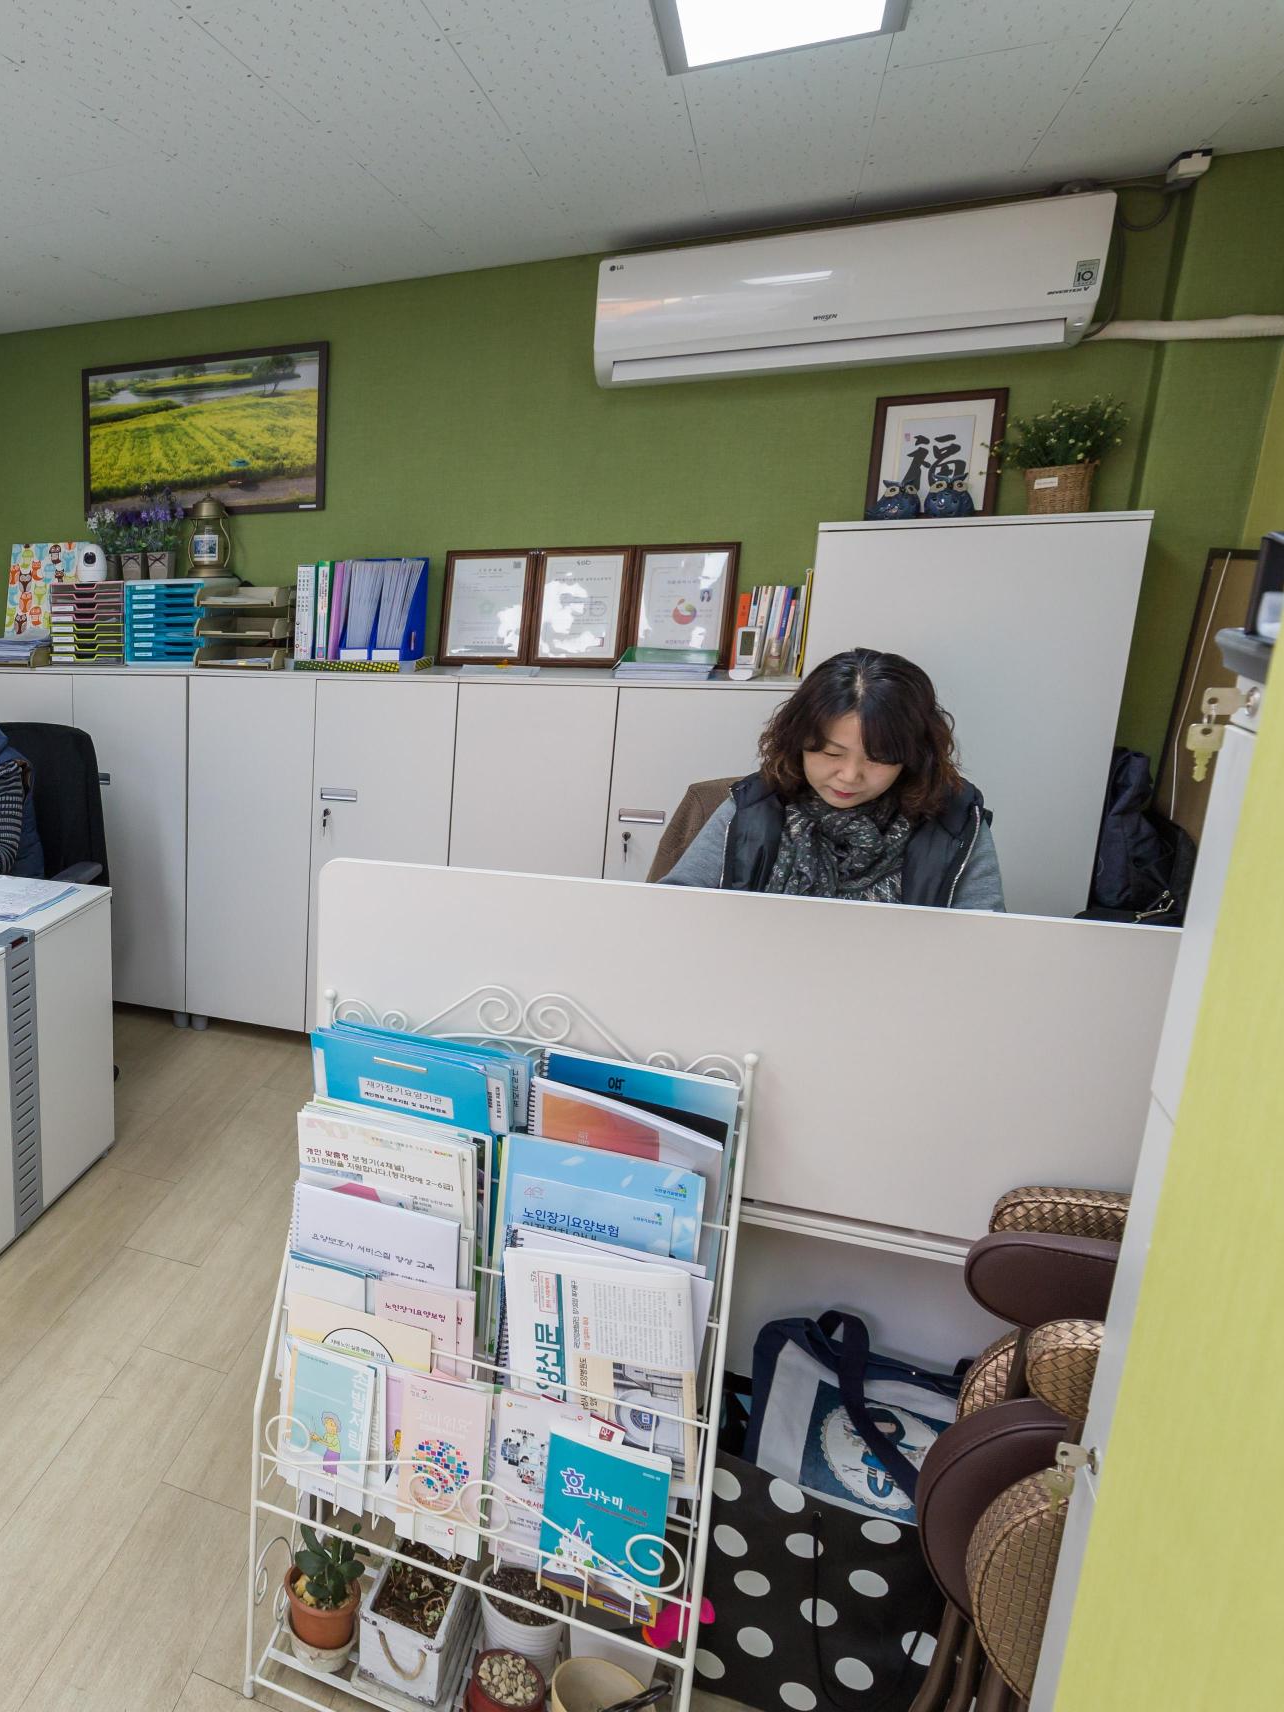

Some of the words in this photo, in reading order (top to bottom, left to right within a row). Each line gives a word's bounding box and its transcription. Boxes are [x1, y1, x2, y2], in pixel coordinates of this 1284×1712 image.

[1077, 270, 1094, 281] 10
[901, 433, 968, 490] 福
[523, 1207, 619, 1238] 노인장기요양보험
[385, 1302, 446, 1323] 노인장기요양보험
[535, 1322, 561, 1391] 양신문
